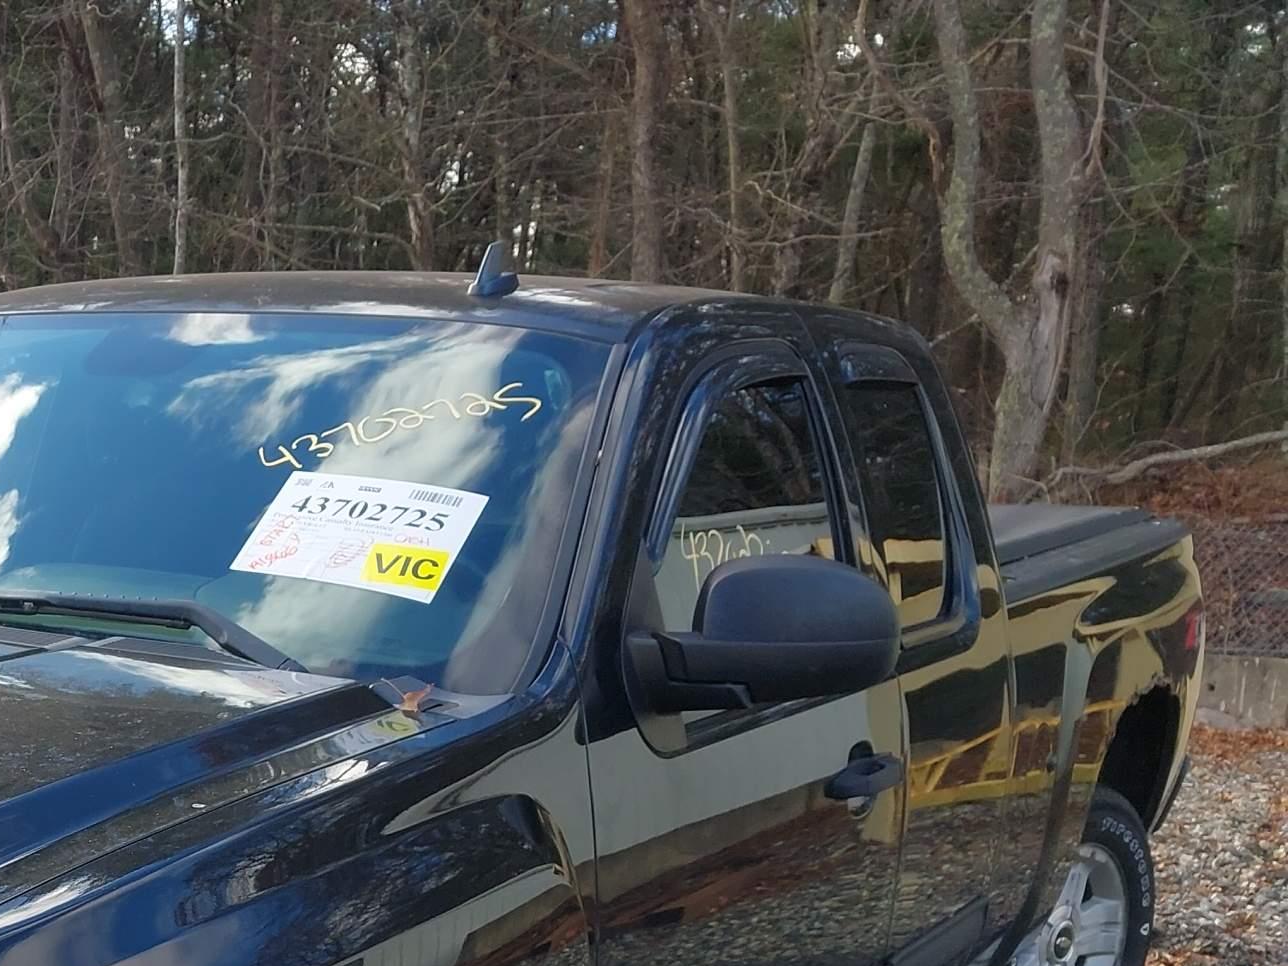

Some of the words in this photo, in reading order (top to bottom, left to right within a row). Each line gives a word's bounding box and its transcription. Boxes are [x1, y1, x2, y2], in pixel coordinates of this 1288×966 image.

[258, 382, 542, 468] 43702725
[291, 495, 450, 532] 43702725
[375, 552, 440, 581] VIC
